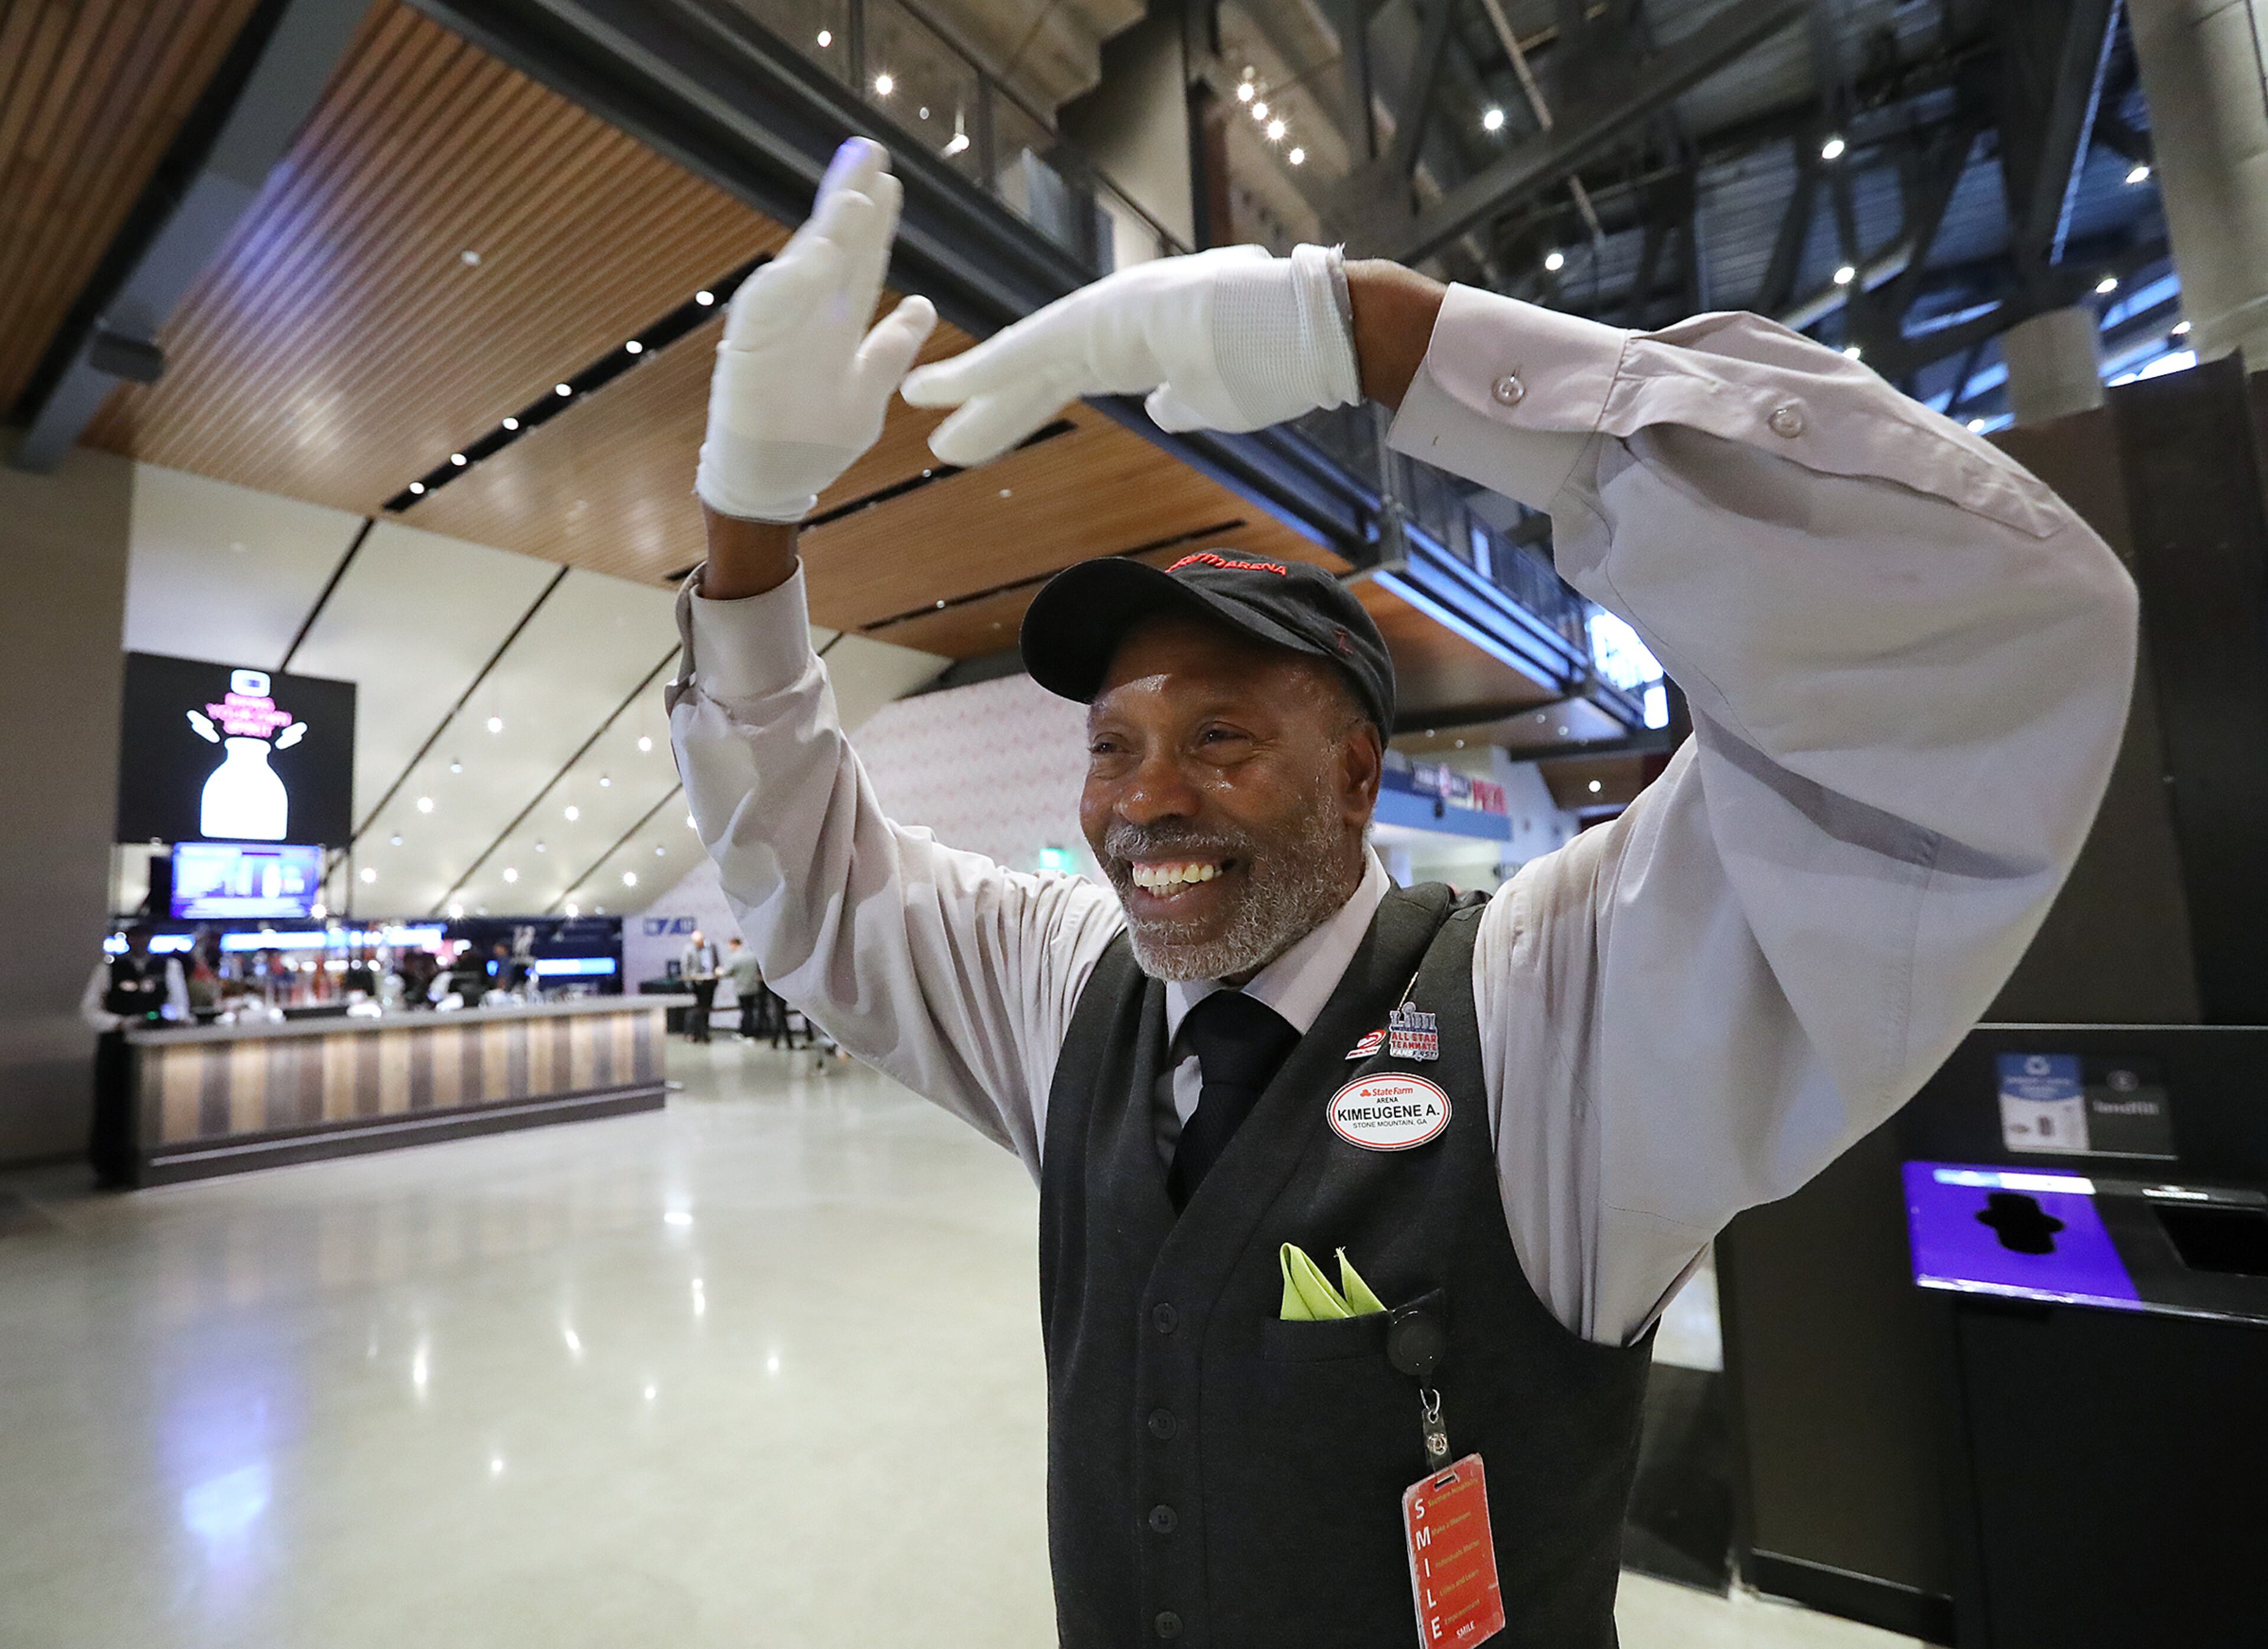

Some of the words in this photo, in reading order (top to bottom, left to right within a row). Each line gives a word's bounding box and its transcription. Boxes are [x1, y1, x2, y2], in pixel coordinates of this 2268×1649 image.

[1223, 560, 1287, 577] ARENA
[1391, 1032, 1409, 1041] ALL
[1412, 1034, 1437, 1042] STAR
[1392, 1041, 1437, 1051] TEAMMATE
[1338, 1104, 1422, 1122] KIMEUGENE
[1426, 1104, 1440, 1116] A.
[1377, 1119, 1415, 1127] MOUNTAIN,
[1456, 1621, 1475, 1639] SMILE
